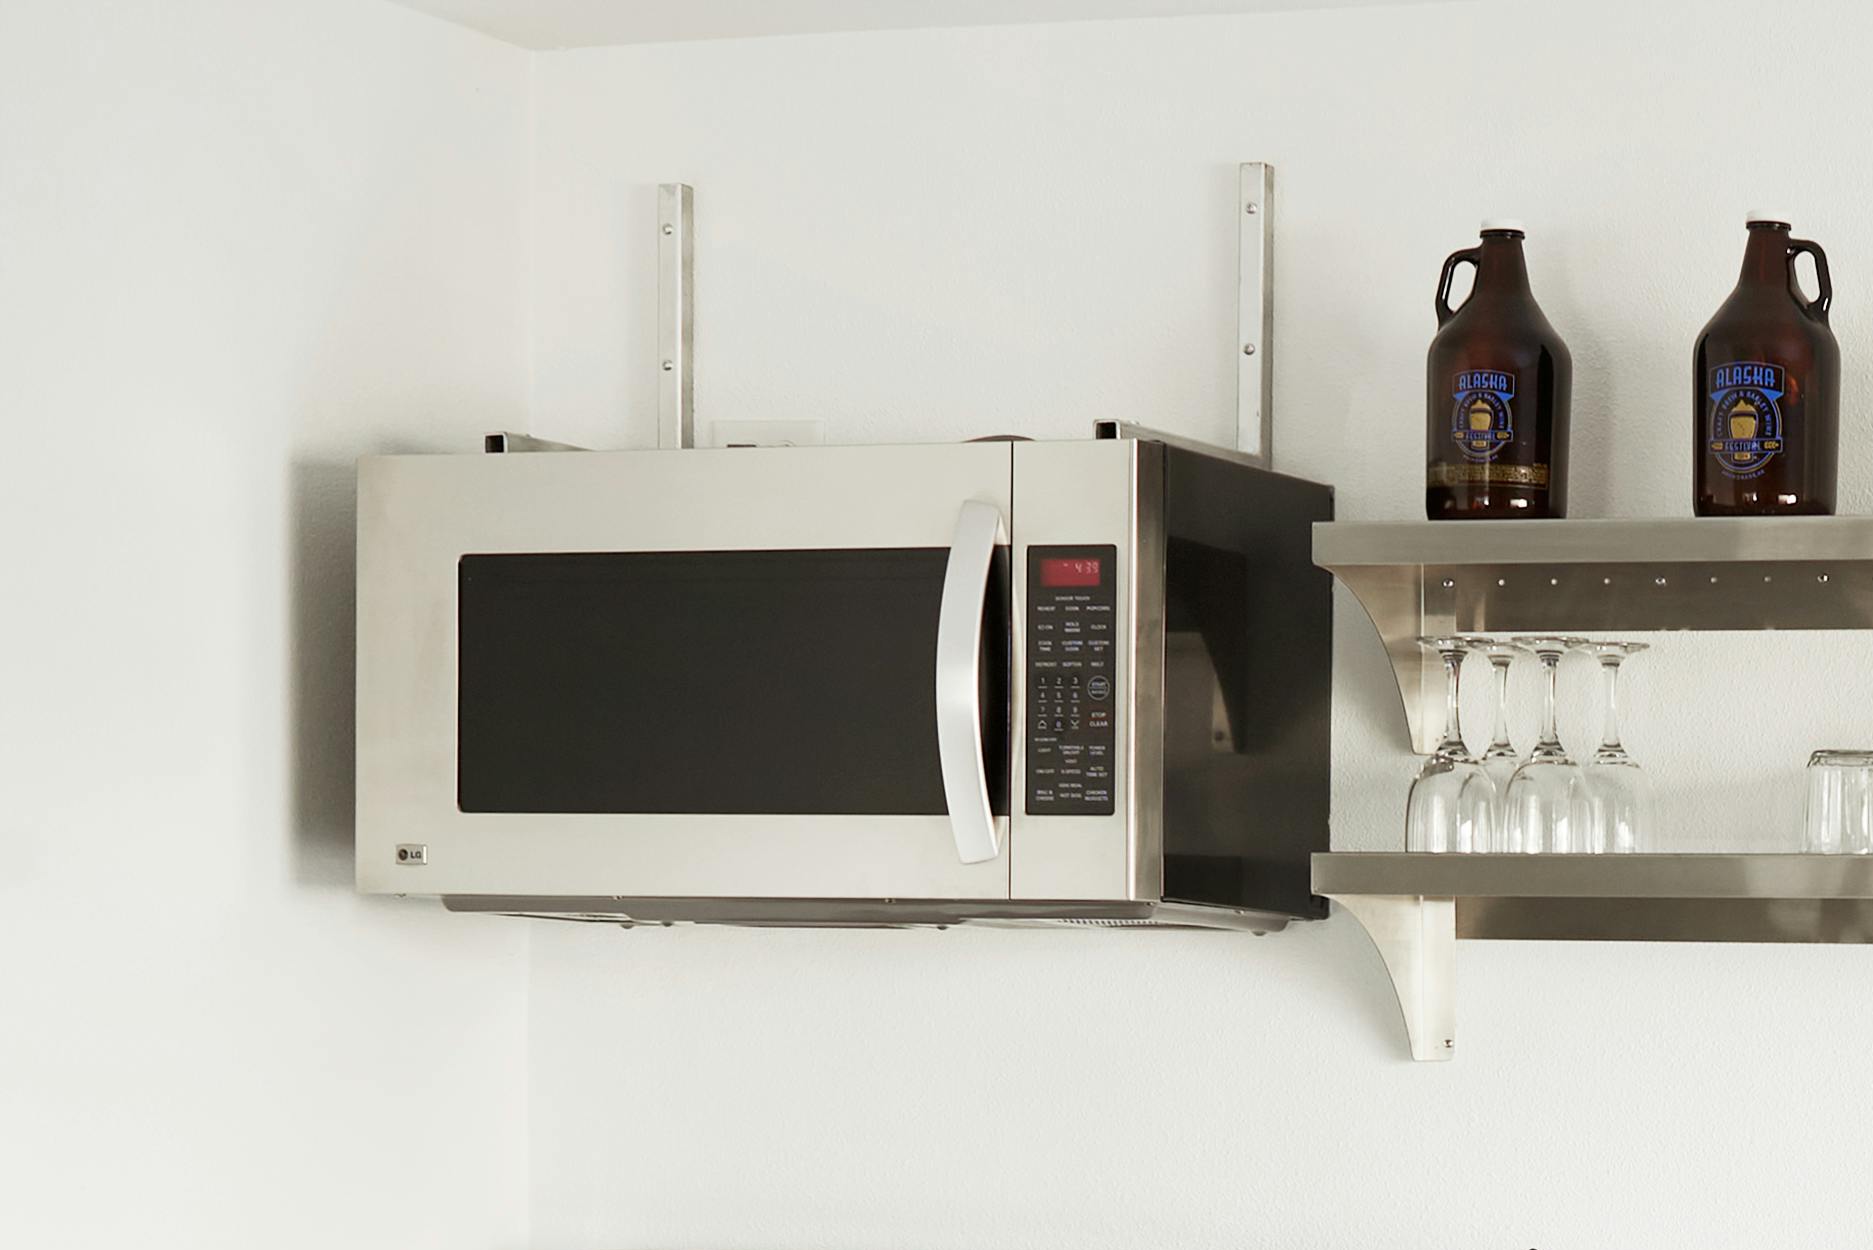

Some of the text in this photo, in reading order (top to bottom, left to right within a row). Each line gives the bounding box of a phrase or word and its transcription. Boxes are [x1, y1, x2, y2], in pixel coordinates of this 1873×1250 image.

[1457, 372, 1508, 391] ALASKA
[1715, 365, 1776, 389] ALASKA
[1725, 442, 1762, 451] FESTIVAL
[410, 851, 421, 859] LG
